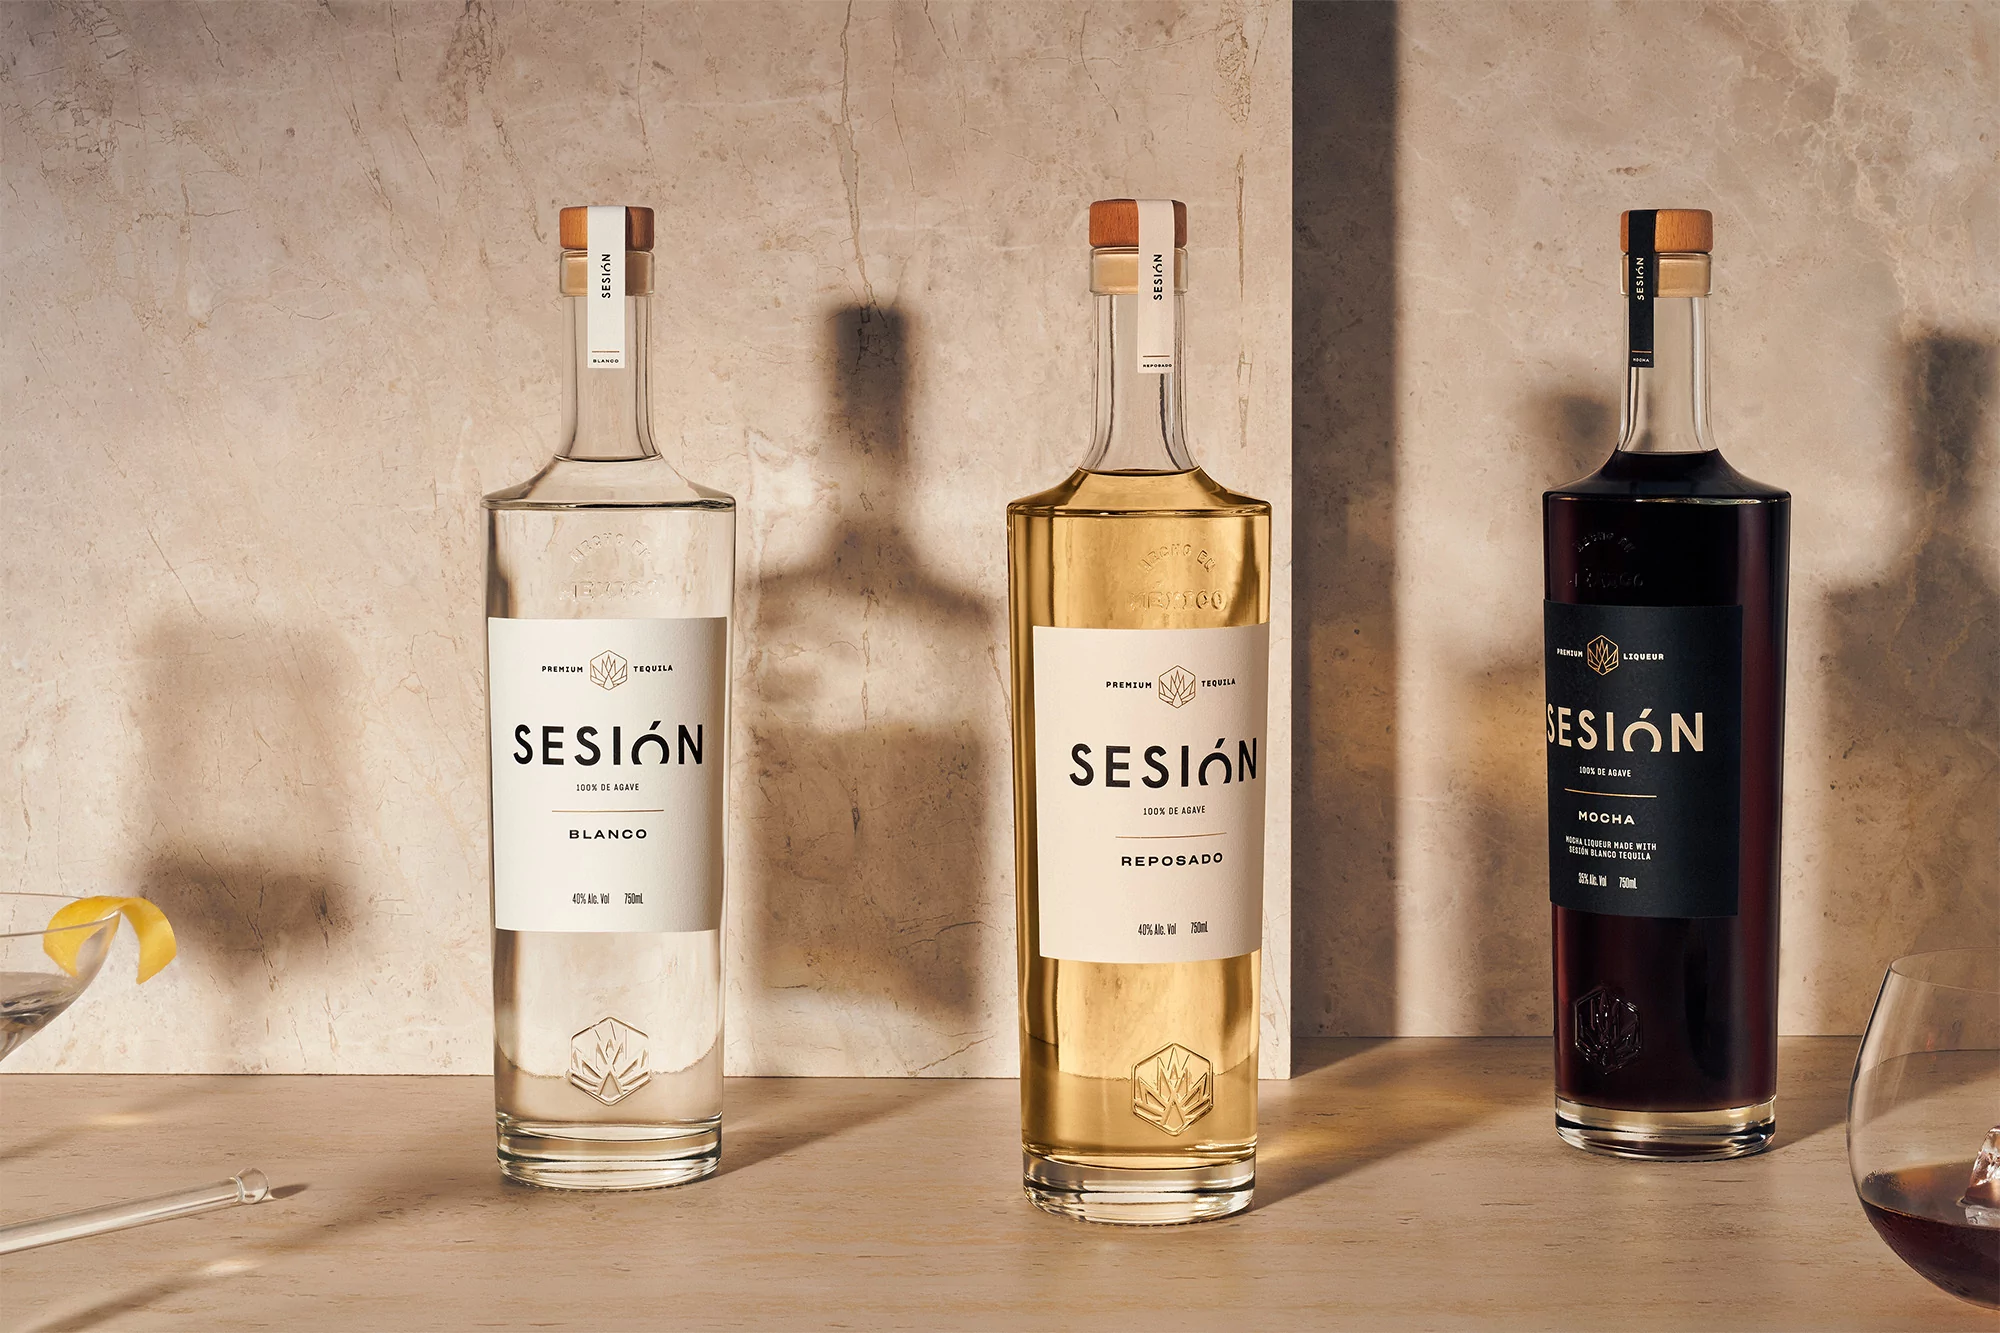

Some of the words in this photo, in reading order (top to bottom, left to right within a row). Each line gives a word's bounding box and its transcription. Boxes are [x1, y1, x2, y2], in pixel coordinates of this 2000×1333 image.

[601, 253, 611, 299] SESIÓN
[1152, 254, 1163, 300] SESIÓN
[1635, 257, 1645, 301] SESIÓN
[1556, 648, 1583, 657] PREMIUM
[1623, 652, 1665, 661] LIQUEUR
[541, 665, 584, 673] PREMIUM
[633, 664, 674, 673] TEQUILA
[1105, 681, 1152, 689] PREMIUM
[1201, 677, 1236, 687] TEQUILA
[1547, 703, 1704, 752] SESIÓN
[513, 720, 703, 766] SESIÓN
[1069, 737, 1258, 789] SESIÓN
[1579, 766, 1596, 775] 100%
[1597, 768, 1606, 776] DE
[1608, 768, 1632, 778] AGAVE
[576, 783, 598, 792] 100%
[600, 783, 611, 792] DE
[613, 783, 640, 791] AGAVE
[1143, 807, 1166, 816] 100%
[1168, 806, 1178, 815] DE
[1181, 805, 1206, 814] AGAVE
[1578, 810, 1635, 825] MOCHA
[569, 829, 647, 840] BLANCO
[1565, 835, 1583, 846] MOCHA
[1584, 838, 1612, 849] LIQUEUR
[1613, 841, 1633, 851] MADE
[1635, 842, 1657, 851] WITH
[1121, 852, 1223, 867] REPOSADO
[1568, 845, 1589, 856] SESIÓN
[1590, 850, 1617, 859] BLANCO
[1619, 851, 1651, 861] TEQUILA
[1599, 874, 1607, 887] Vol
[572, 892, 587, 905] 40%
[588, 892, 599, 905] Alc.
[600, 892, 610, 905] Vol
[624, 892, 644, 905] 750mL
[1138, 923, 1153, 936] 40%
[1154, 923, 1166, 936] Alc.
[1166, 922, 1177, 936] Vol
